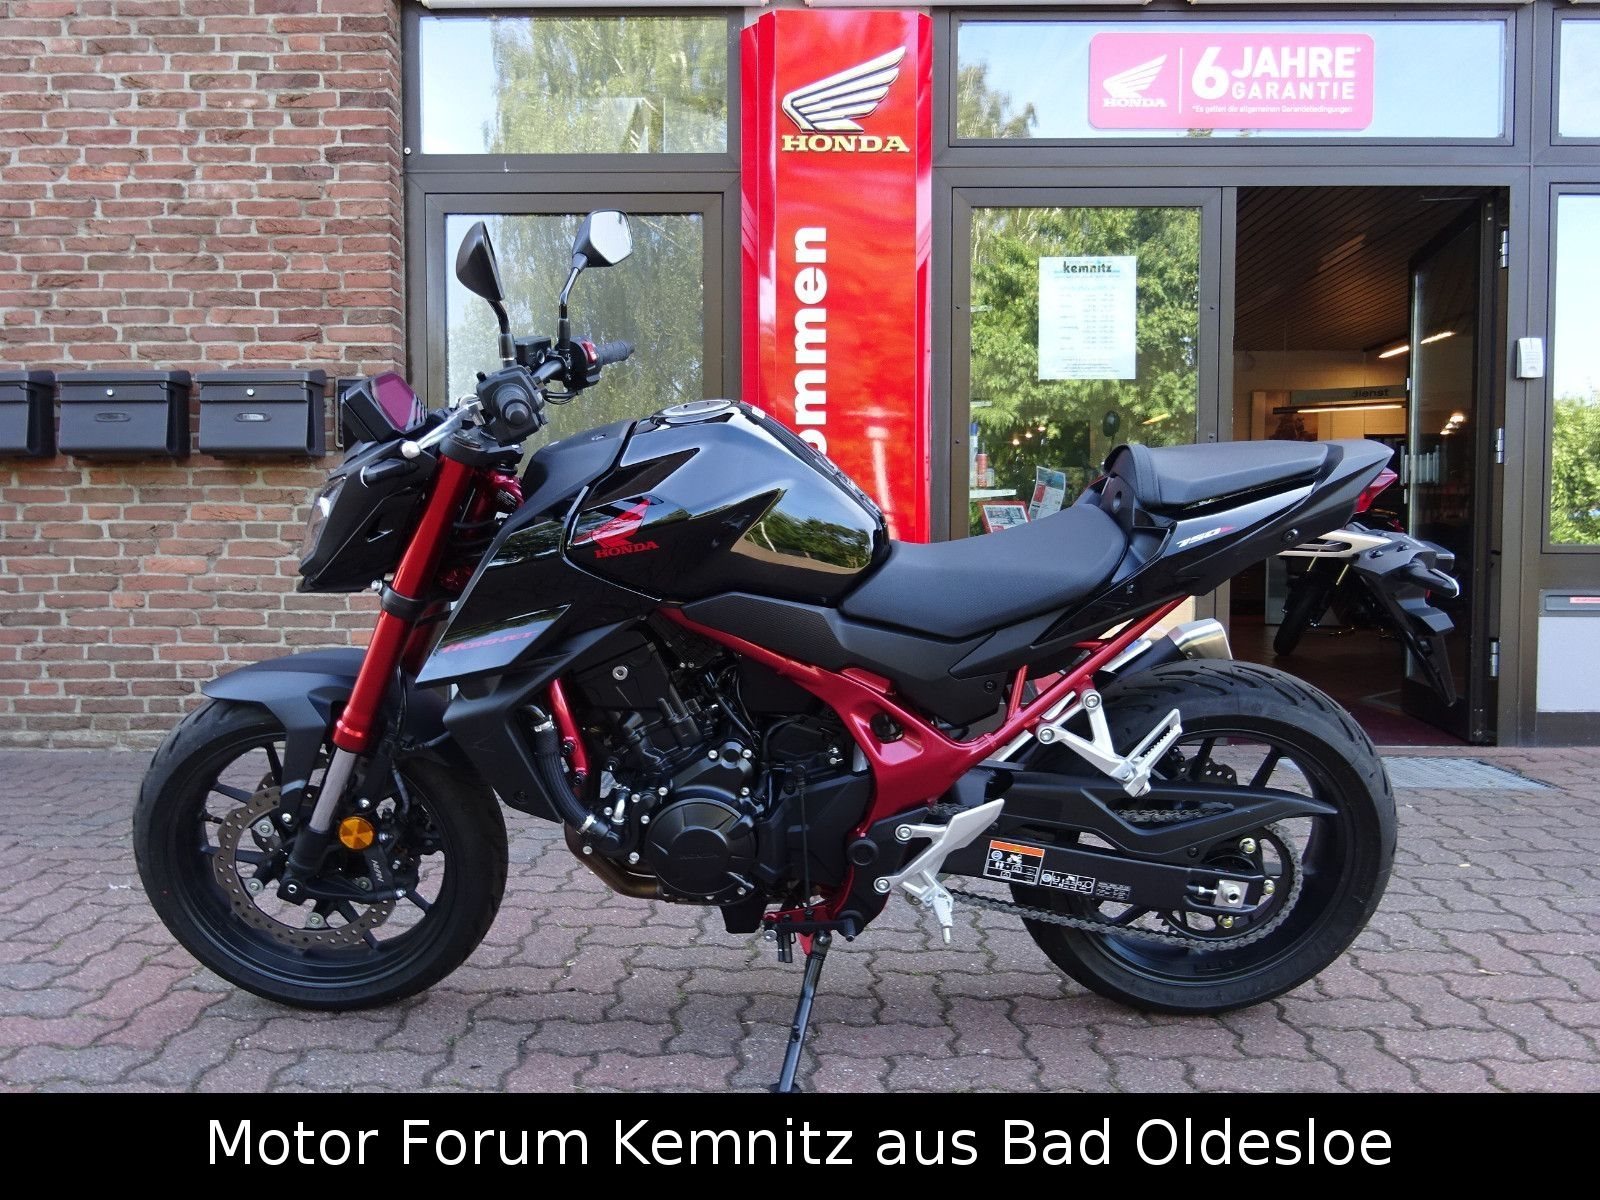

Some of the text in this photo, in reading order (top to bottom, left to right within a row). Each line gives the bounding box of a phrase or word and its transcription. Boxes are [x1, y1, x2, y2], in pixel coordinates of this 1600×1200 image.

[1190, 45, 1230, 101] 6
[1231, 81, 1355, 100] GARANTIE
[1103, 97, 1168, 108] HONDA
[781, 134, 910, 153] HONDA
[1063, 260, 1112, 274] kemnitz
[594, 541, 660, 559] HONDA
